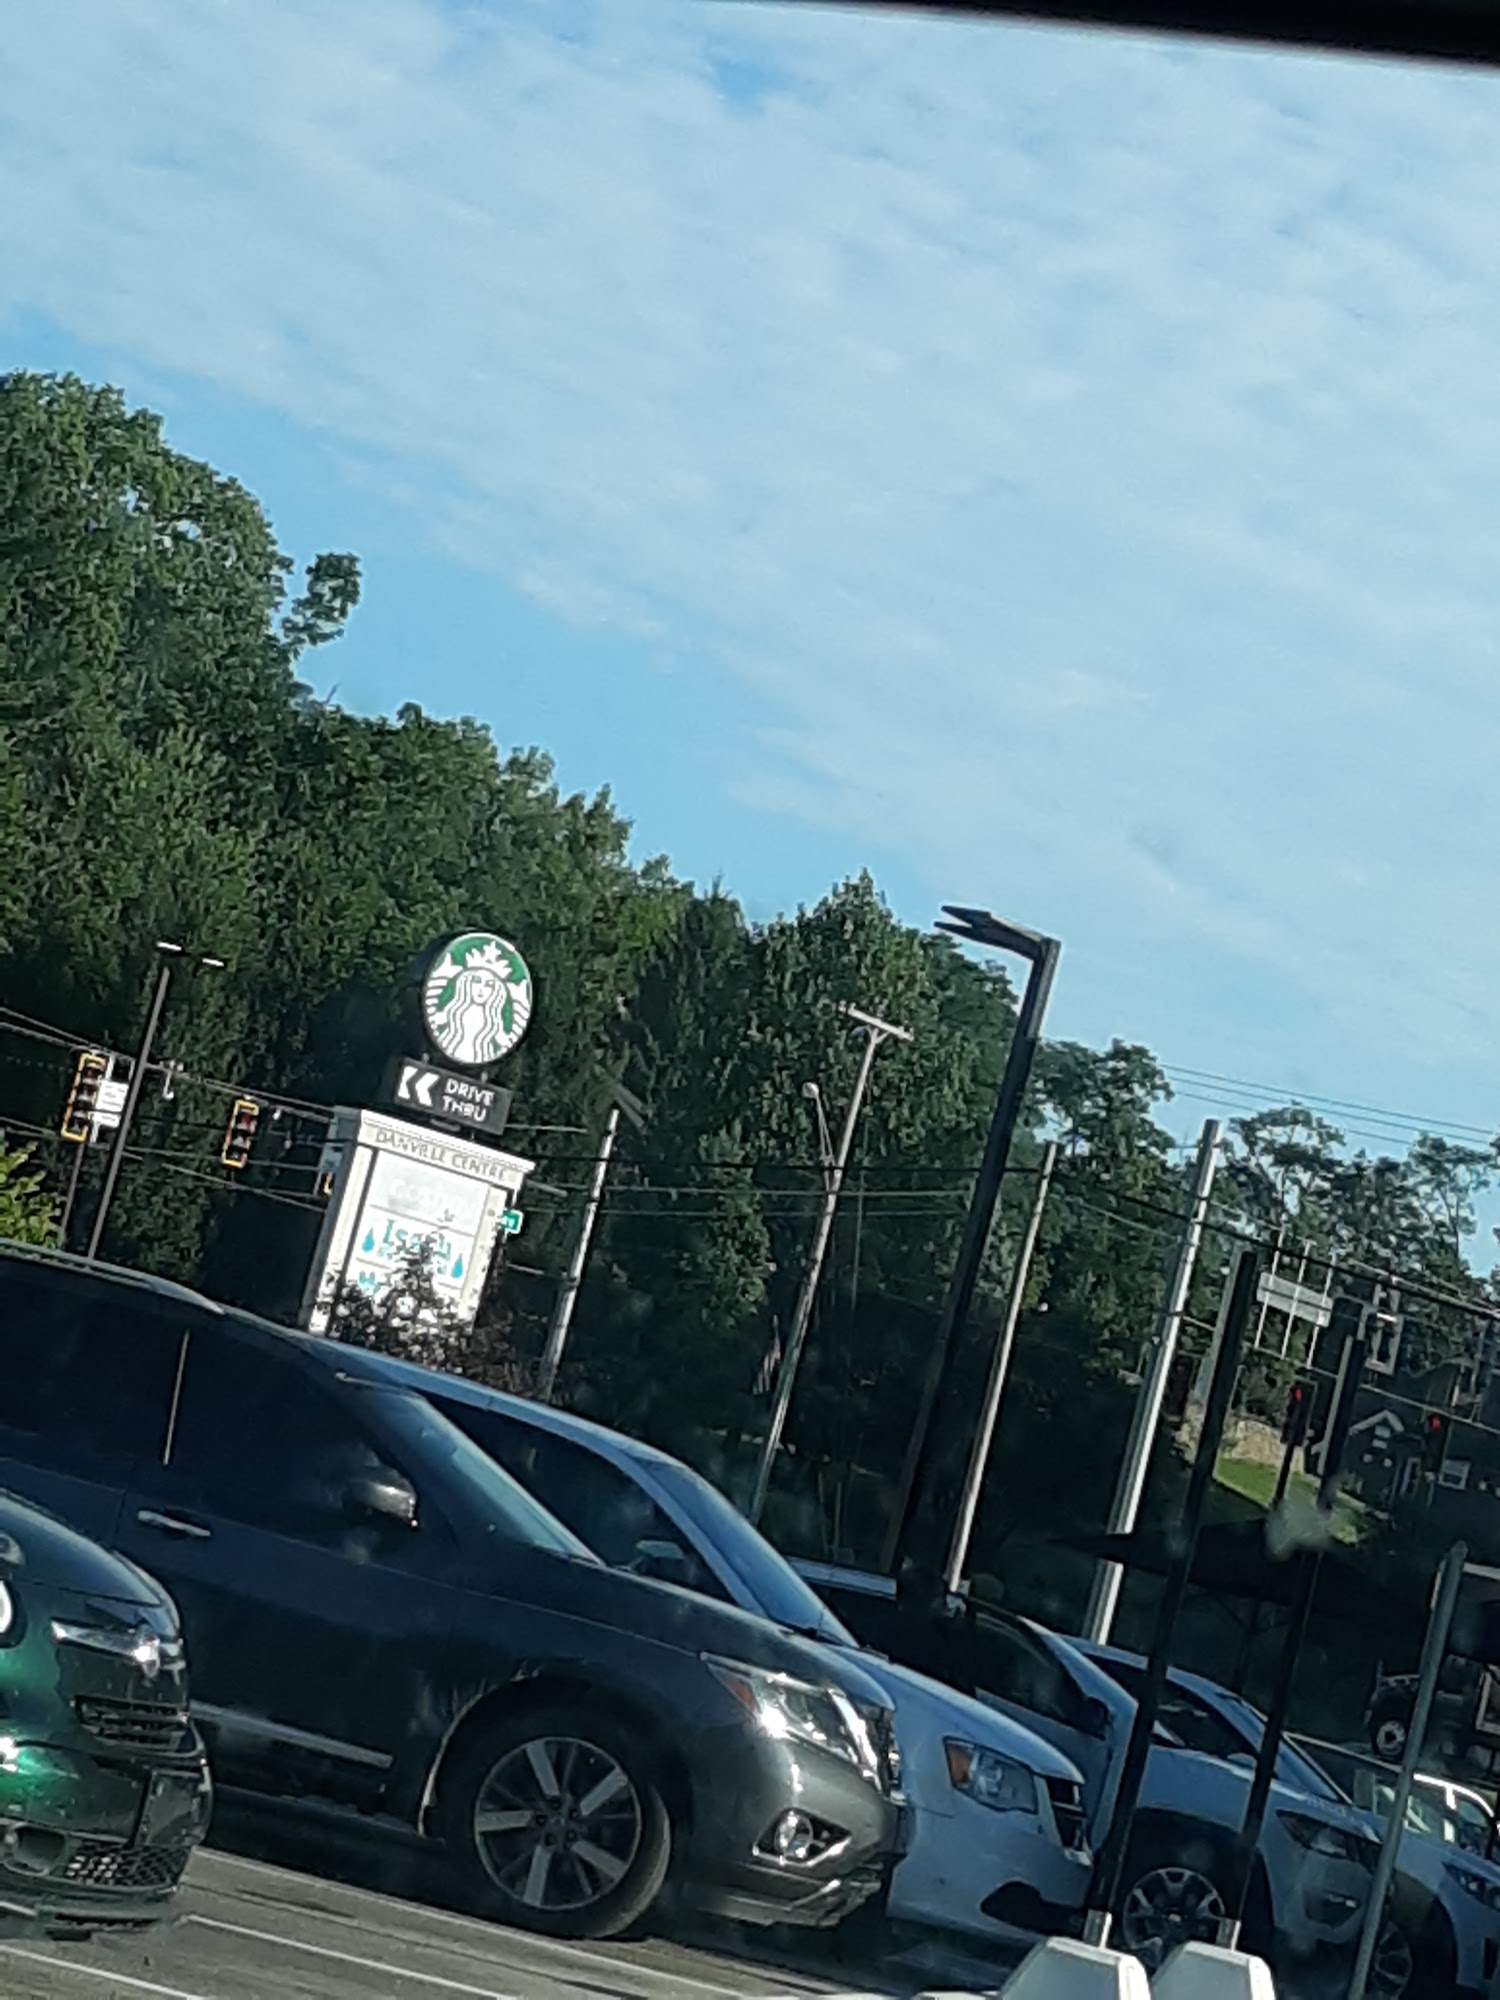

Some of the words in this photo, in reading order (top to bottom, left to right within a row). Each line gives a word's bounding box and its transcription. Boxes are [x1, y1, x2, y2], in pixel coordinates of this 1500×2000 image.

[445, 1078, 495, 1107] DRIVE
[442, 1095, 487, 1122] THRU
[452, 1152, 505, 1182] CENTRE
